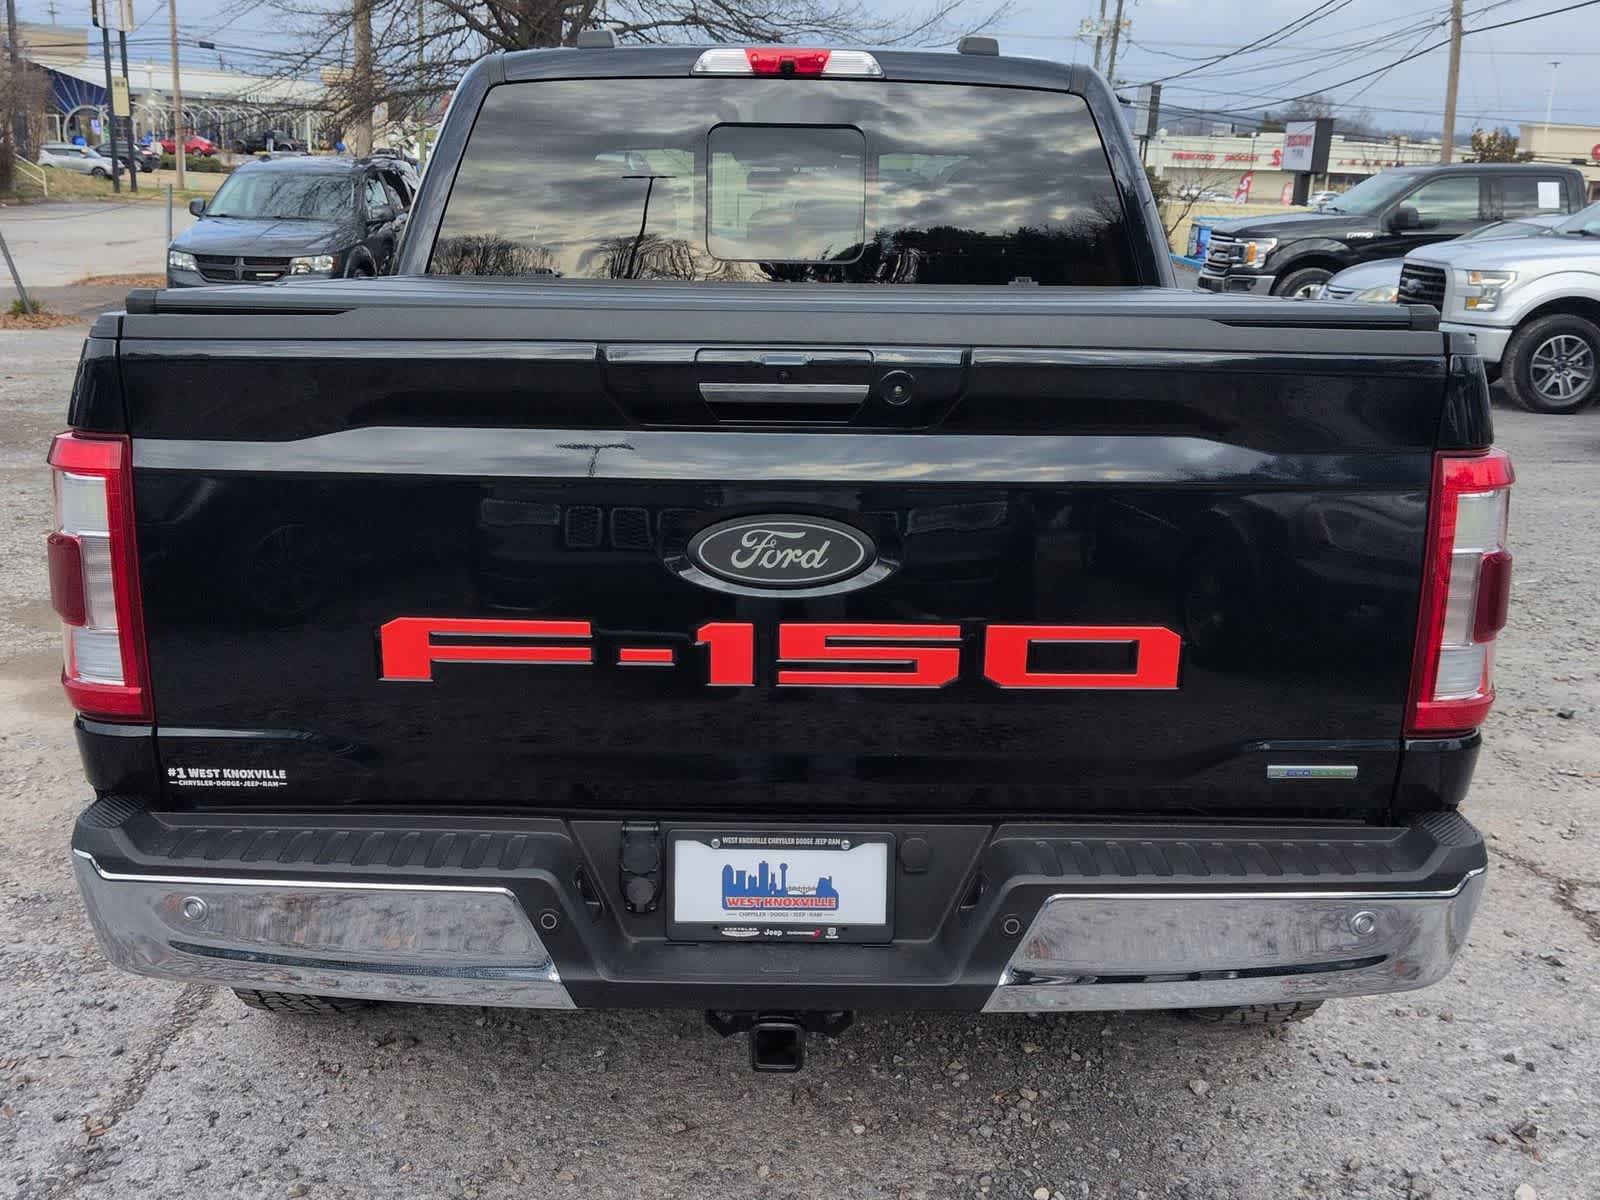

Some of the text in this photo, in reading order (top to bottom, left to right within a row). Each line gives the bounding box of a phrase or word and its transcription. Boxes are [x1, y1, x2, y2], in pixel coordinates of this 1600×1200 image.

[731, 529, 831, 569] Ford
[378, 616, 1184, 691] F-150
[187, 768, 220, 778] WEST
[222, 768, 287, 779] KNOXVILLE
[722, 836, 738, 844] WEST
[768, 837, 795, 845] CHRYSLER
[828, 838, 841, 846] RAM
[726, 896, 837, 908] WEST KNOXVILLE
[764, 928, 783, 937] Jeep
